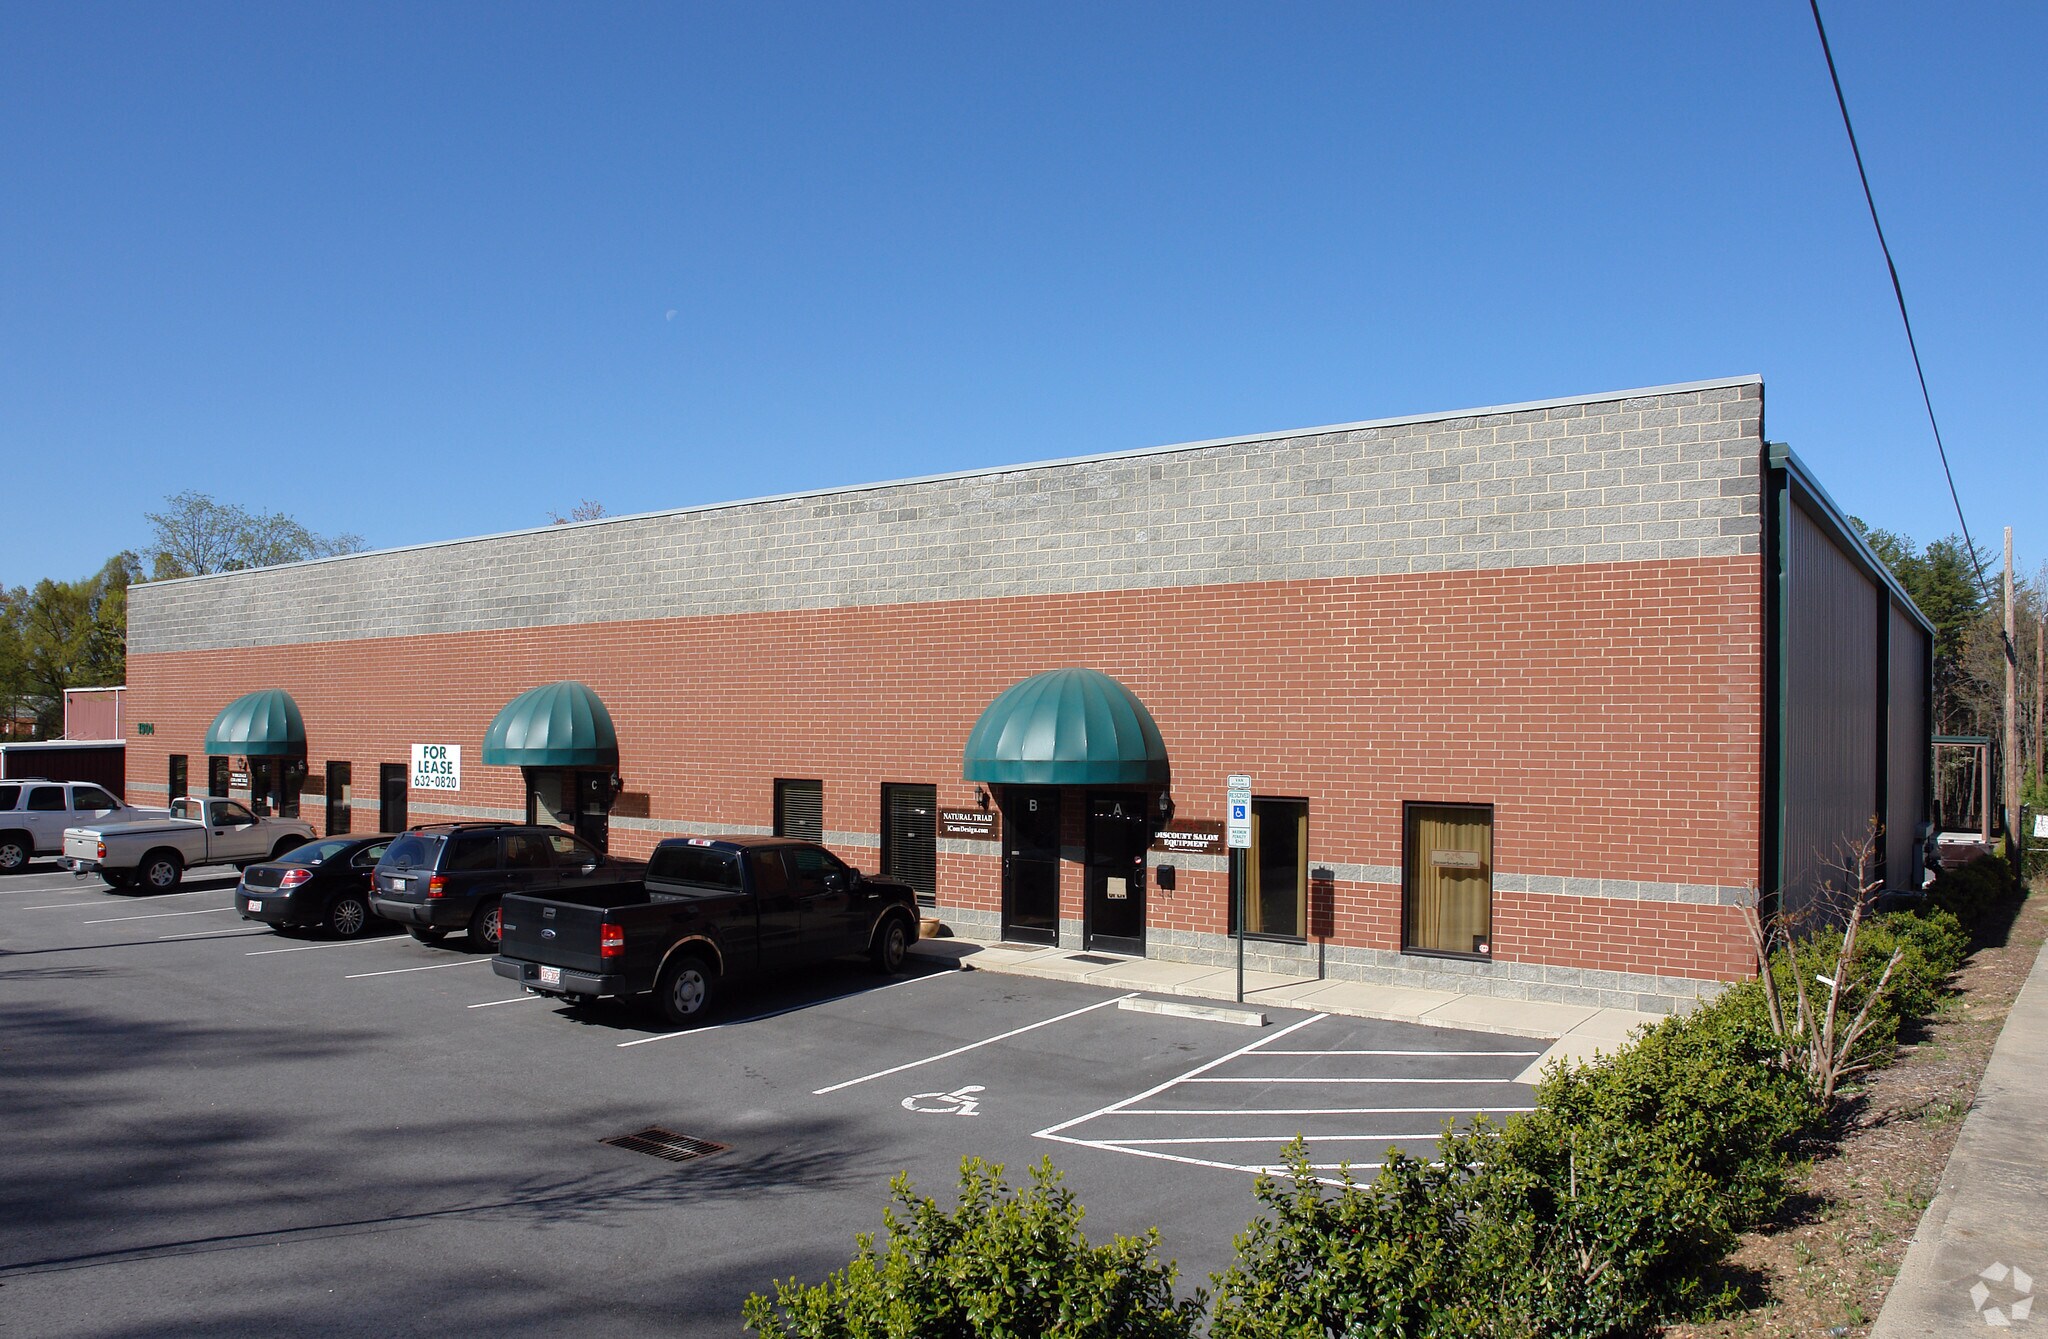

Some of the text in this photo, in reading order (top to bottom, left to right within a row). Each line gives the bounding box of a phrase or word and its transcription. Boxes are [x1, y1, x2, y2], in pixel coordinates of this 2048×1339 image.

[423, 745, 447, 760] FOR
[418, 760, 453, 775] LEASE
[414, 774, 457, 789] 632-0820
[591, 779, 598, 790] C
[1029, 799, 1038, 812] B
[1113, 803, 1123, 816] A
[943, 812, 993, 822] NATURAL TRIAD
[1154, 831, 1219, 841] DISCOUNT SALON
[1163, 839, 1209, 848] EQUIPMENT
